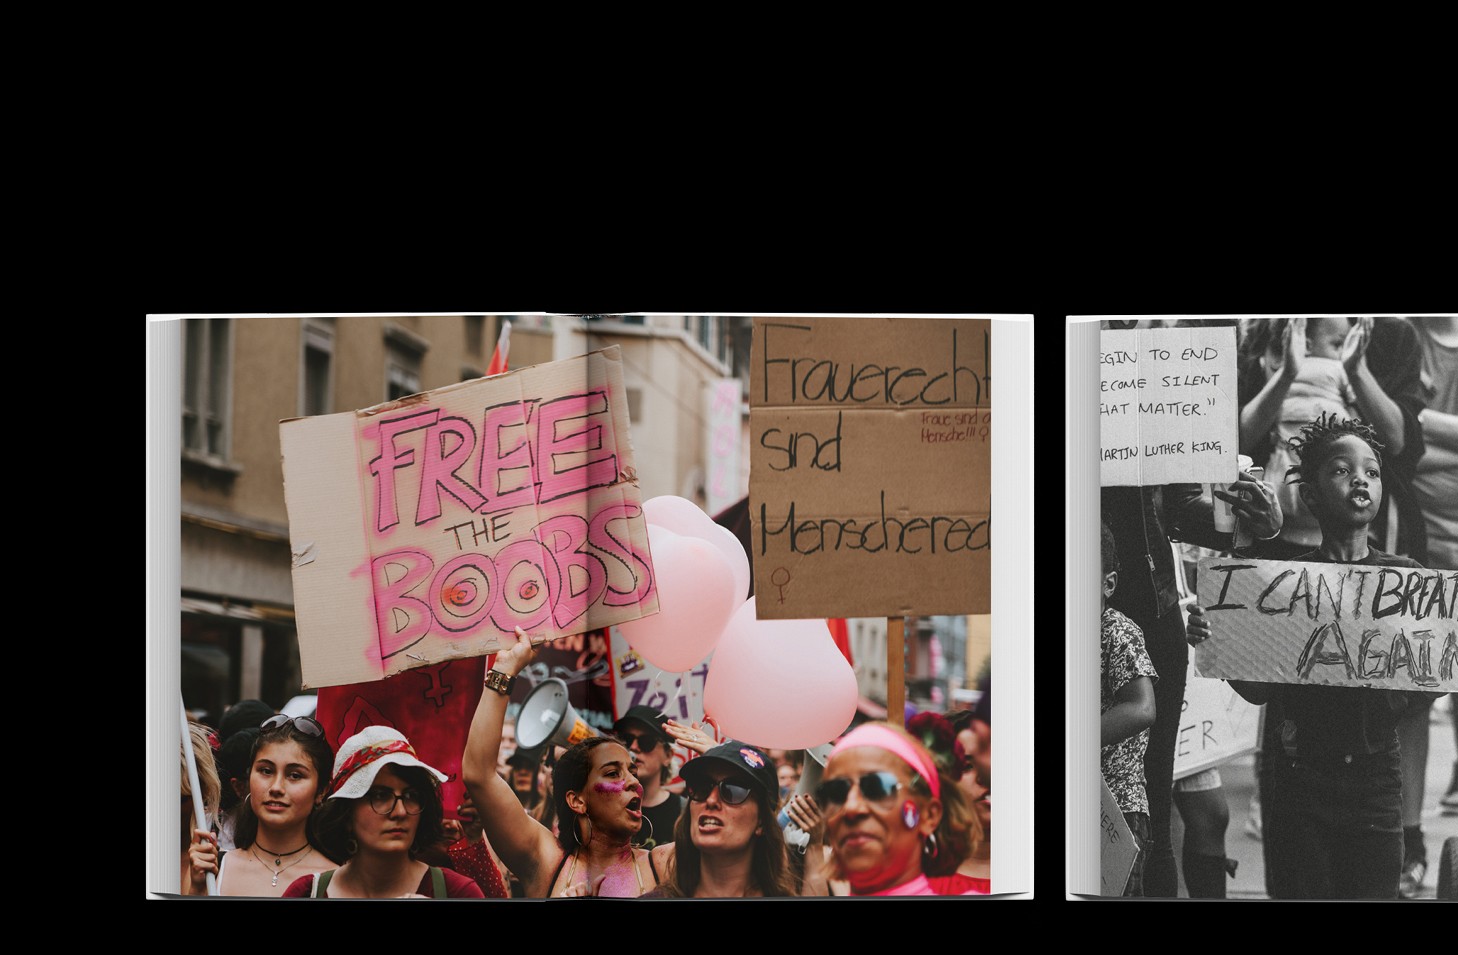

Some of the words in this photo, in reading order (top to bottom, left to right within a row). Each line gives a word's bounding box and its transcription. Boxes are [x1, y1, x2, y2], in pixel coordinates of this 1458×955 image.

[1148, 349, 1170, 361] TO
[1181, 347, 1218, 361] END
[1101, 379, 1147, 392] ECOME
[1161, 374, 1220, 387] SILENT
[369, 390, 619, 532] FREE
[760, 410, 842, 472] sind
[1145, 442, 1185, 457] LUTHER
[443, 511, 515, 550] THE
[371, 504, 653, 660] BOOBS
[1205, 564, 1257, 612] I
